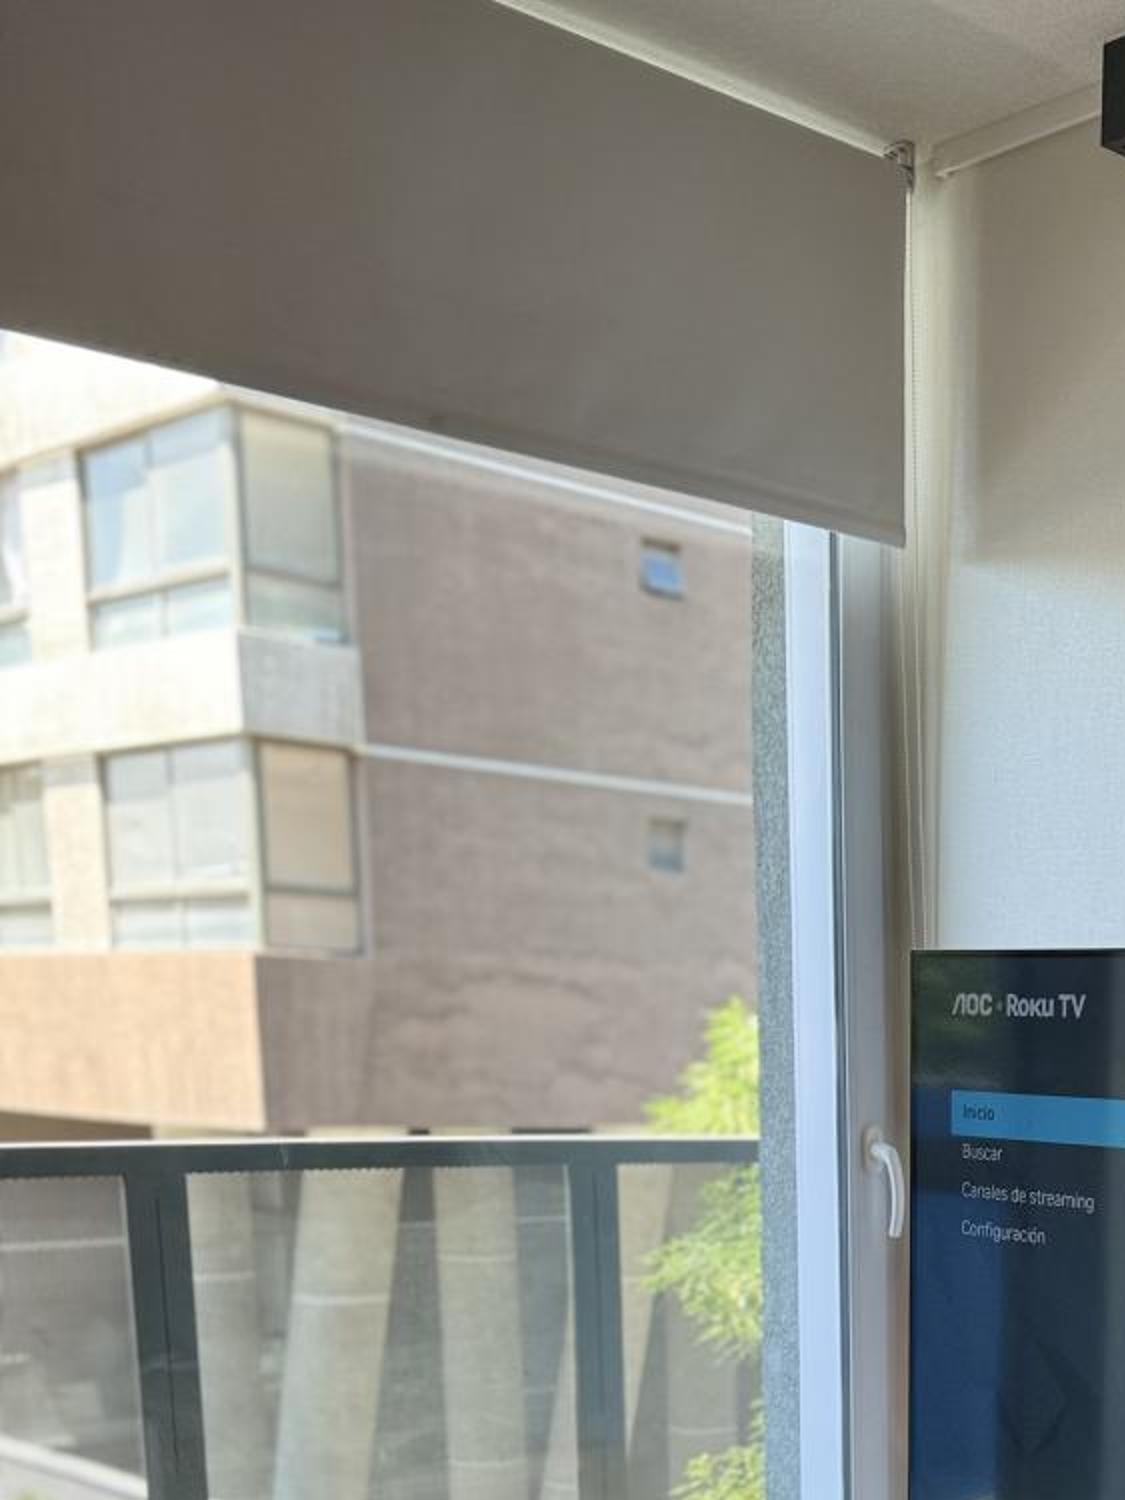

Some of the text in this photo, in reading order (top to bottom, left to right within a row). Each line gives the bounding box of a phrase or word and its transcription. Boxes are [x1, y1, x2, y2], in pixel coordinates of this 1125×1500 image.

[1006, 994, 1055, 1017] Roku
[1058, 994, 1087, 1019] TV
[963, 1103, 995, 1121] Inicio
[962, 1143, 1003, 1161] Buscar
[961, 1181, 1095, 1215] Canales de streaming
[961, 1219, 1046, 1245] Configuración
